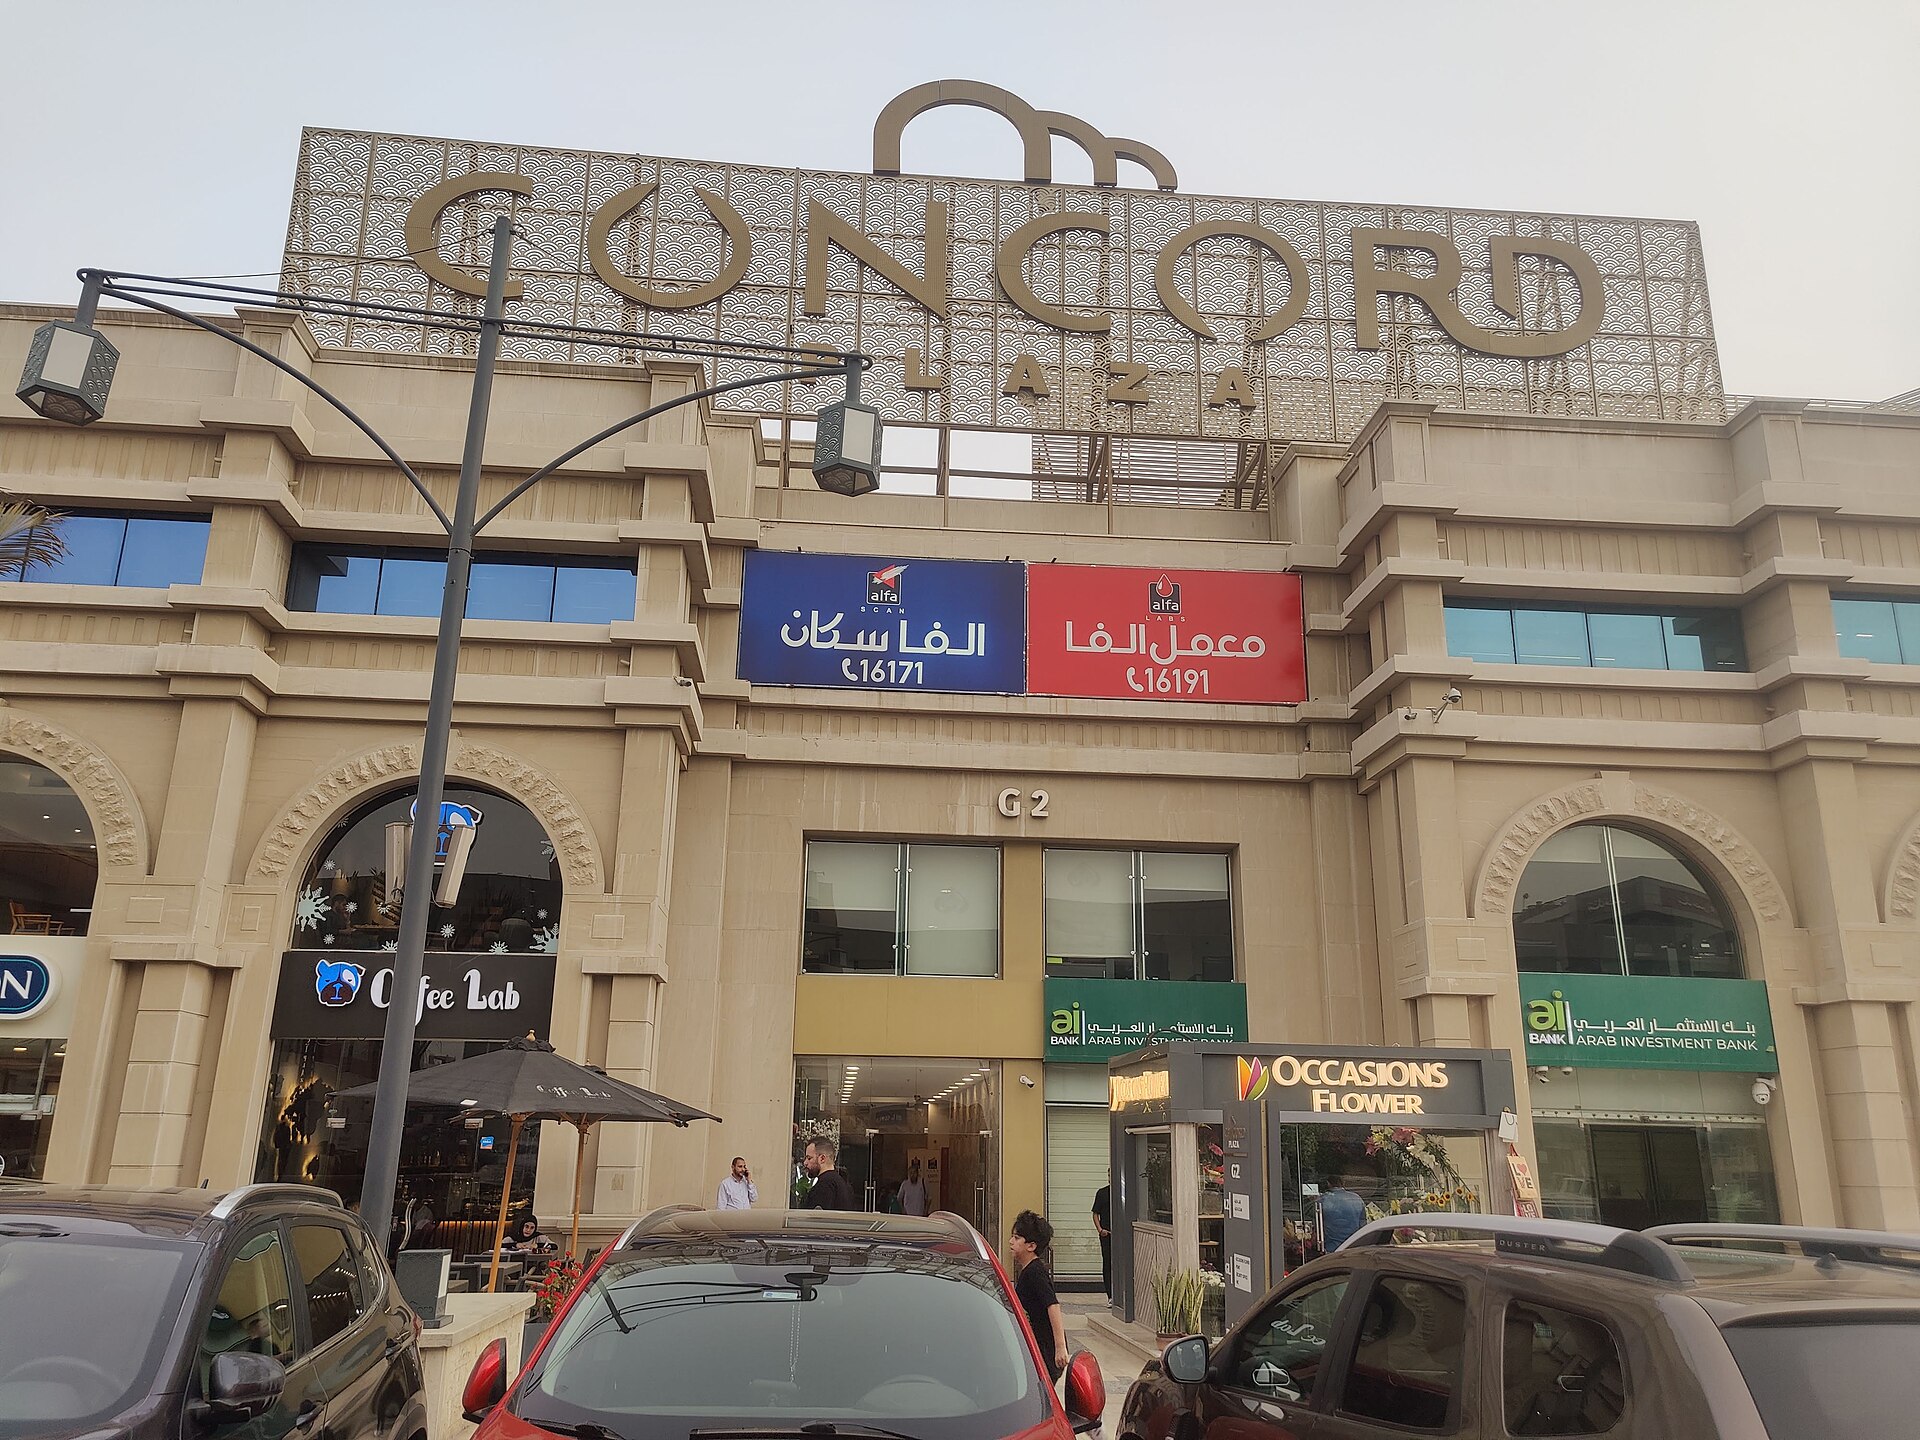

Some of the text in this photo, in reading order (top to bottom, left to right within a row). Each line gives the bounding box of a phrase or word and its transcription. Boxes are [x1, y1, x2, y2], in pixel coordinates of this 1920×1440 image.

[405, 170, 1605, 359] CONCORD
[870, 589, 898, 602] alfa
[860, 606, 905, 614] SCAN
[1152, 599, 1179, 612] alfa
[781, 610, 986, 657] الفا سكان
[1066, 621, 1266, 665] معمل الفا
[860, 659, 924, 684] 16171
[1144, 668, 1209, 694] 16191
[0, 970, 33, 999] N
[463, 968, 520, 1011] Lab
[1087, 1021, 1145, 1035] العربي
[1206, 1024, 1234, 1037] بنك
[1573, 1017, 1756, 1037] بنك الاستثمار العربي
[1050, 1036, 1079, 1046] BANK
[1088, 1036, 1121, 1046] ARAB
[1529, 1033, 1567, 1045] BANK
[1576, 1036, 1758, 1051] ARAB INVESTMENT BANK
[1271, 1055, 1449, 1088] OCCASIONS
[1312, 1089, 1425, 1114] FLOWER
[1499, 1239, 1546, 1252] DUSTER
